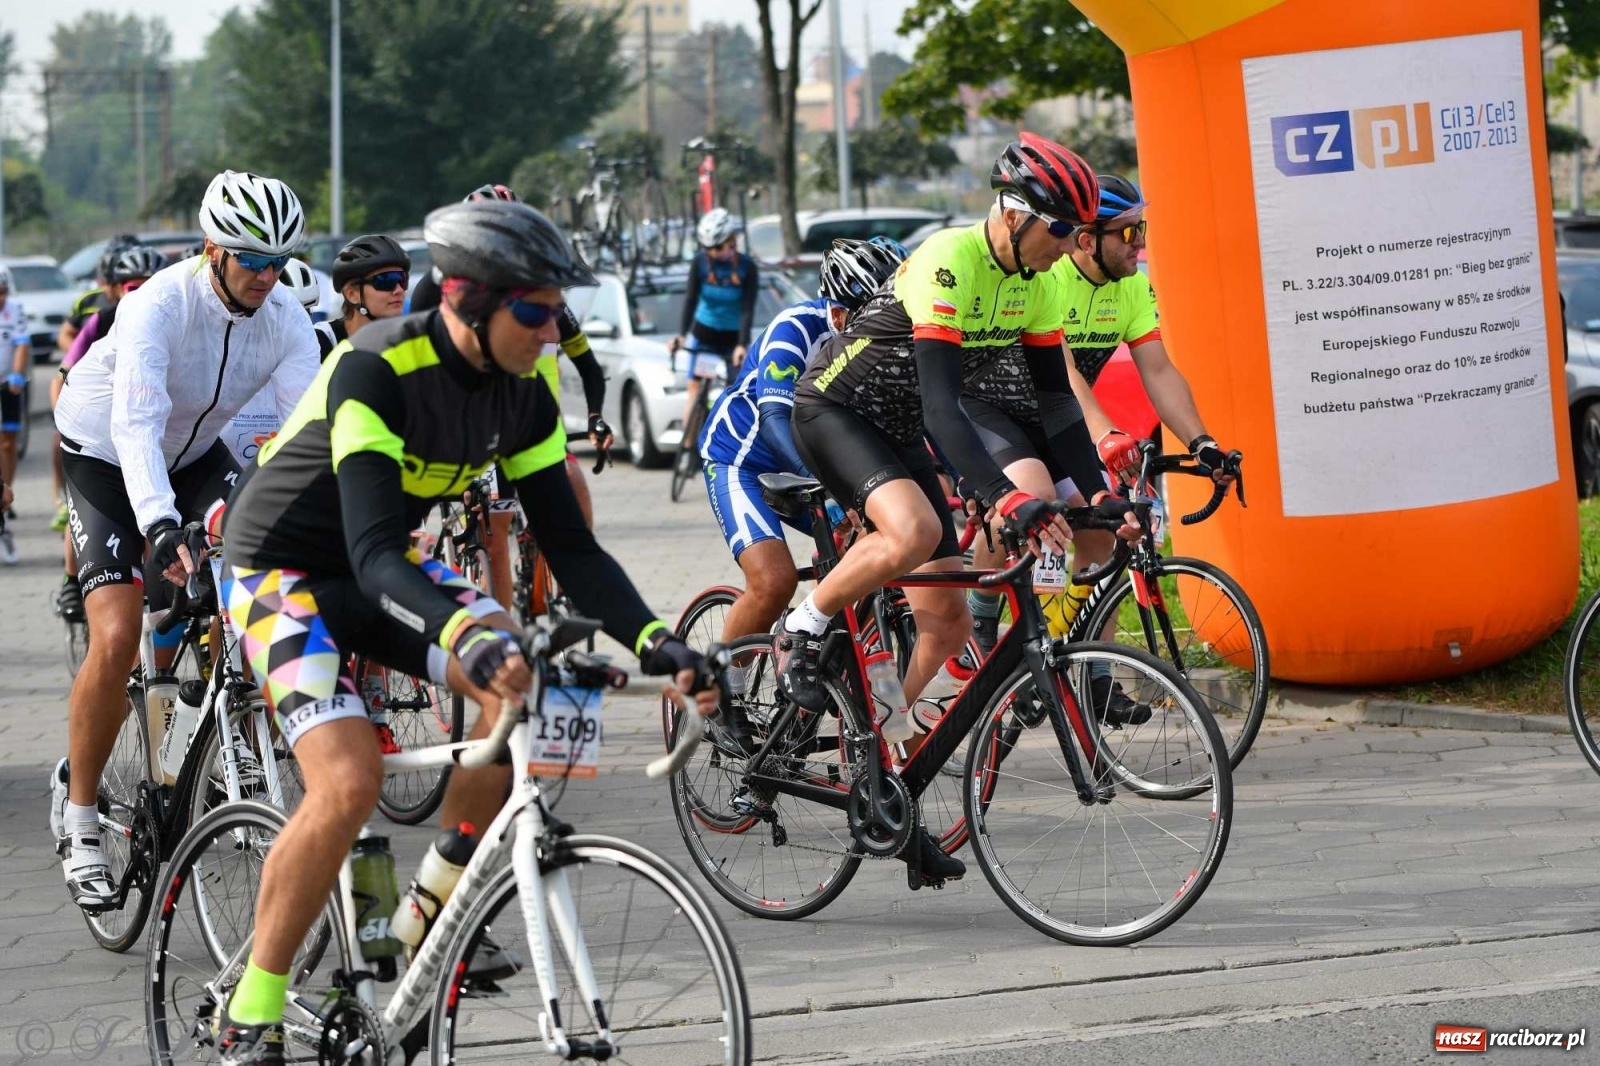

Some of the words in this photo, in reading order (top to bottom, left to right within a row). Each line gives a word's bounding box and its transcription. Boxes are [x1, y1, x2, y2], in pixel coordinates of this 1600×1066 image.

[1316, 244, 1363, 259] Projekt
[1367, 245, 1375, 254] o
[1379, 238, 1433, 252] numerze
[1436, 226, 1511, 247] rejestracyjnym
[1282, 280, 1303, 292] PL.
[1306, 267, 1430, 291] 3.22/3.304/09.01281
[1433, 267, 1453, 281] pn:
[1488, 258, 1505, 270] bez
[1295, 310, 1319, 325] jest
[1322, 299, 1441, 322] współfinansowany
[1444, 297, 1455, 307] w
[1457, 292, 1480, 306] 85%
[1482, 293, 1494, 302] ze
[1496, 284, 1531, 300] środków
[1322, 333, 1416, 351] Europejskiego
[1420, 324, 1477, 342] Funduszu
[1480, 317, 1520, 334] Rozwoju
[1311, 366, 1401, 384] Regionalnego
[1404, 362, 1432, 375] oraz
[1435, 358, 1450, 372] do
[1453, 355, 1477, 369] 10%
[1479, 354, 1492, 365] ze
[1494, 346, 1531, 363] środków
[1304, 399, 1355, 414] budżetu
[1359, 394, 1414, 412] państwa
[68, 498, 89, 552] BORA
[536, 715, 597, 743] 1509
